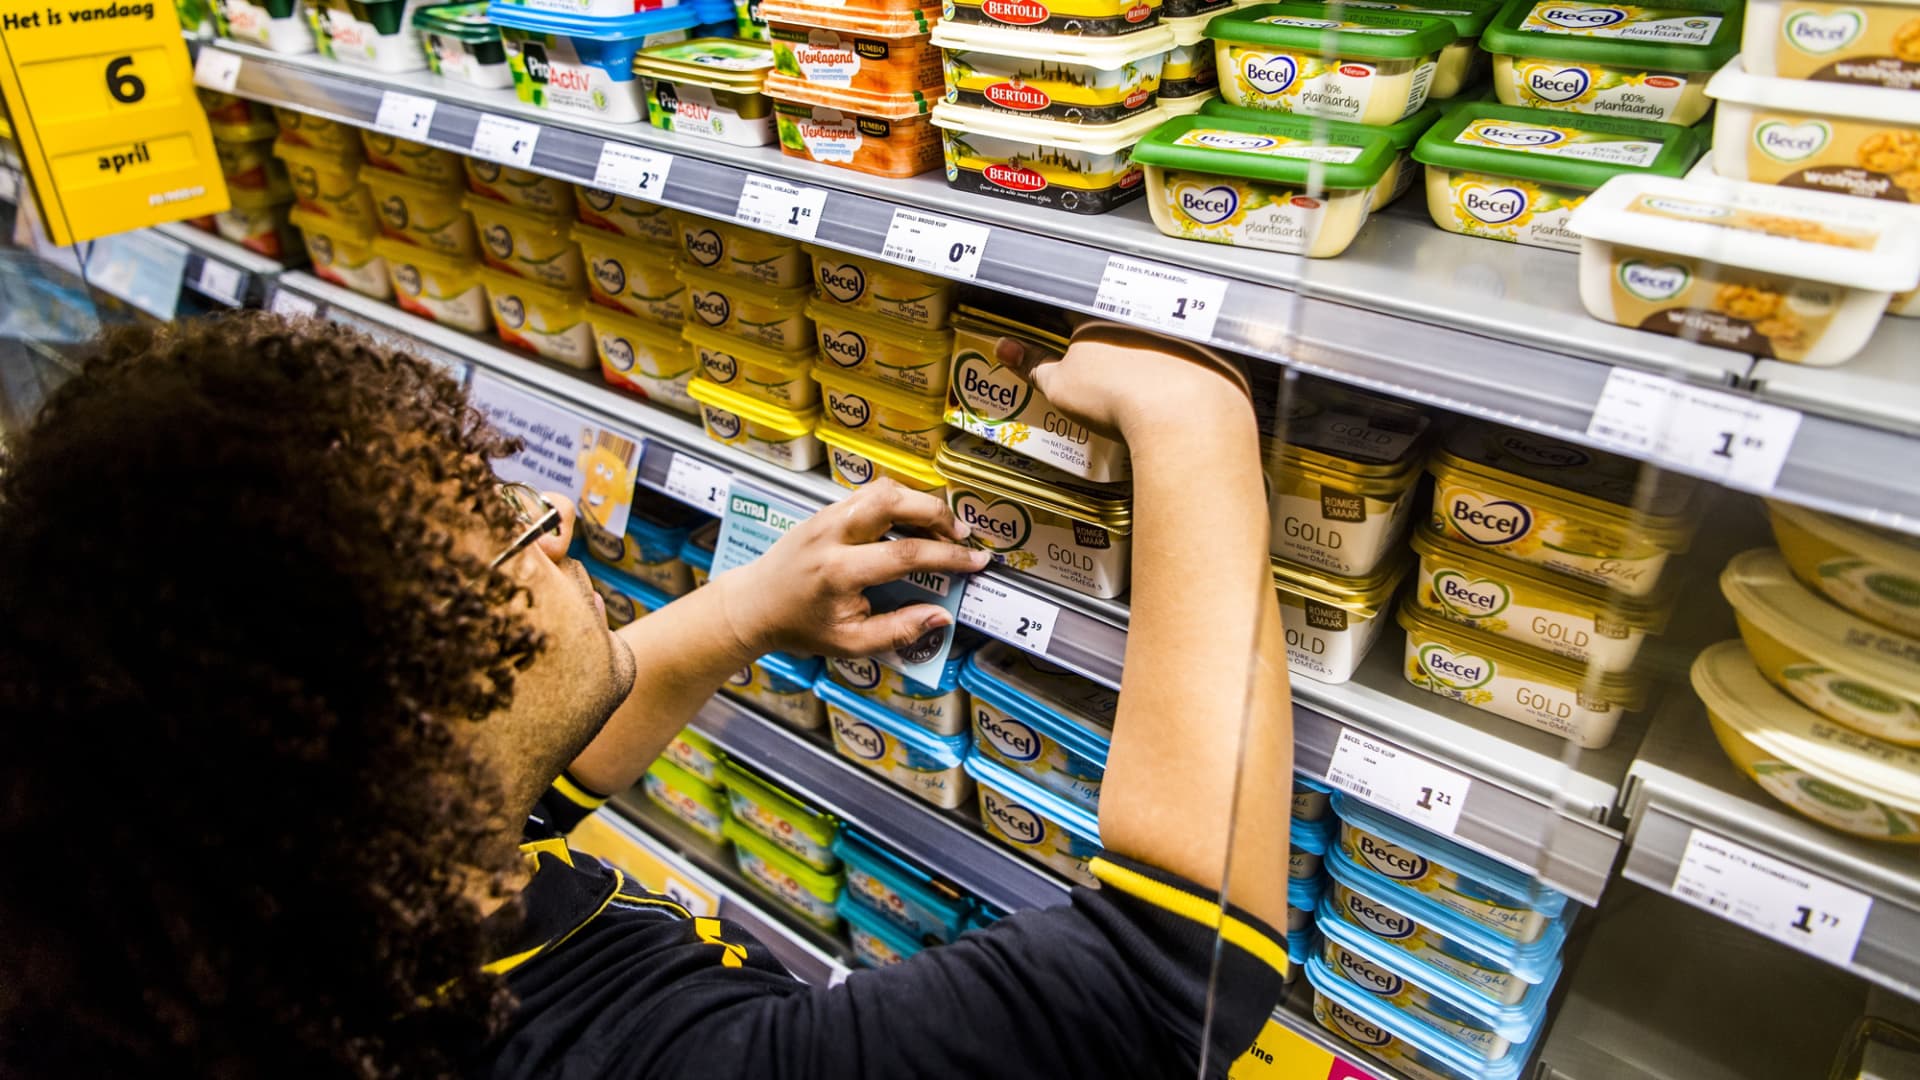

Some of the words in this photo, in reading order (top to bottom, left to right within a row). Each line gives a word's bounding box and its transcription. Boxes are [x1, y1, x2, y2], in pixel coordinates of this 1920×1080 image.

[3, 14, 41, 31] Het
[48, 10, 62, 26] is
[72, 3, 155, 24] vandaag
[989, 1, 1043, 19] BERTOLLI
[1547, 8, 1612, 23] Becel
[857, 42, 885, 54] JUMBO
[797, 51, 854, 67] Verlagend
[105, 56, 146, 103] 6
[1248, 64, 1289, 83] Becel
[1533, 74, 1580, 93] Becel
[991, 85, 1044, 106] BERTOLLI
[1594, 101, 1664, 118] plantaardig
[801, 126, 856, 141] Verlagend
[860, 120, 886, 131] JUMBO
[1483, 127, 1548, 142] Becel
[98, 144, 151, 173] april
[639, 171, 649, 189] 2
[990, 168, 1042, 187] BERTOLLI
[1184, 195, 1229, 214] Becel
[1467, 194, 1515, 214] Becel
[788, 206, 800, 225] 1
[686, 233, 719, 256] Becel
[949, 242, 964, 262] 0
[965, 244, 976, 255] 74
[822, 267, 859, 291] Becel
[693, 294, 725, 318] Becel
[898, 303, 928, 319] Original
[1172, 298, 1188, 320] 1
[1191, 299, 1205, 311] 39
[823, 334, 860, 357] Becel
[701, 352, 732, 374] Becel
[899, 370, 928, 385] Original
[964, 367, 1018, 407] Becel
[829, 394, 864, 419] Becel
[1044, 411, 1089, 445] GOLD
[902, 433, 930, 449] Original
[1713, 432, 1734, 459] 1
[835, 452, 867, 477] Becel
[1060, 452, 1085, 468] OMEGA
[708, 487, 716, 502] 1
[732, 498, 765, 519] EXTRA
[1454, 500, 1519, 535] Becel
[964, 503, 1017, 540] Becel
[1285, 516, 1342, 550] GOLD
[1048, 543, 1093, 571] GOLD
[1310, 555, 1342, 570] OMEGA
[1070, 576, 1096, 588] OMEGA
[1445, 581, 1496, 609] Becel
[1016, 617, 1030, 637] 2
[1031, 621, 1042, 631] 39
[1532, 616, 1589, 647] GOLD
[1285, 628, 1325, 654] OLD
[1294, 658, 1325, 674] OMEGA
[1431, 654, 1480, 681] Becel
[909, 702, 944, 718] Light
[1516, 687, 1571, 719] GOLD
[834, 715, 877, 753] Becel
[978, 709, 1031, 755] Becel
[1344, 734, 1361, 745] BECEL
[1363, 742, 1380, 753] GOLD
[1071, 779, 1100, 799] Ligh
[1416, 786, 1433, 810] 1
[1437, 791, 1451, 806] 21
[986, 795, 1035, 838] Becel
[1362, 836, 1417, 875] Becel
[1351, 896, 1405, 933] Becel
[1488, 905, 1528, 925] Light
[1791, 905, 1813, 933] 1
[1341, 951, 1393, 989] Becel
[1472, 967, 1509, 987] Light
[1332, 1005, 1381, 1040] Becel
[1458, 1026, 1496, 1046] Light
[1251, 1043, 1274, 1065] ine
